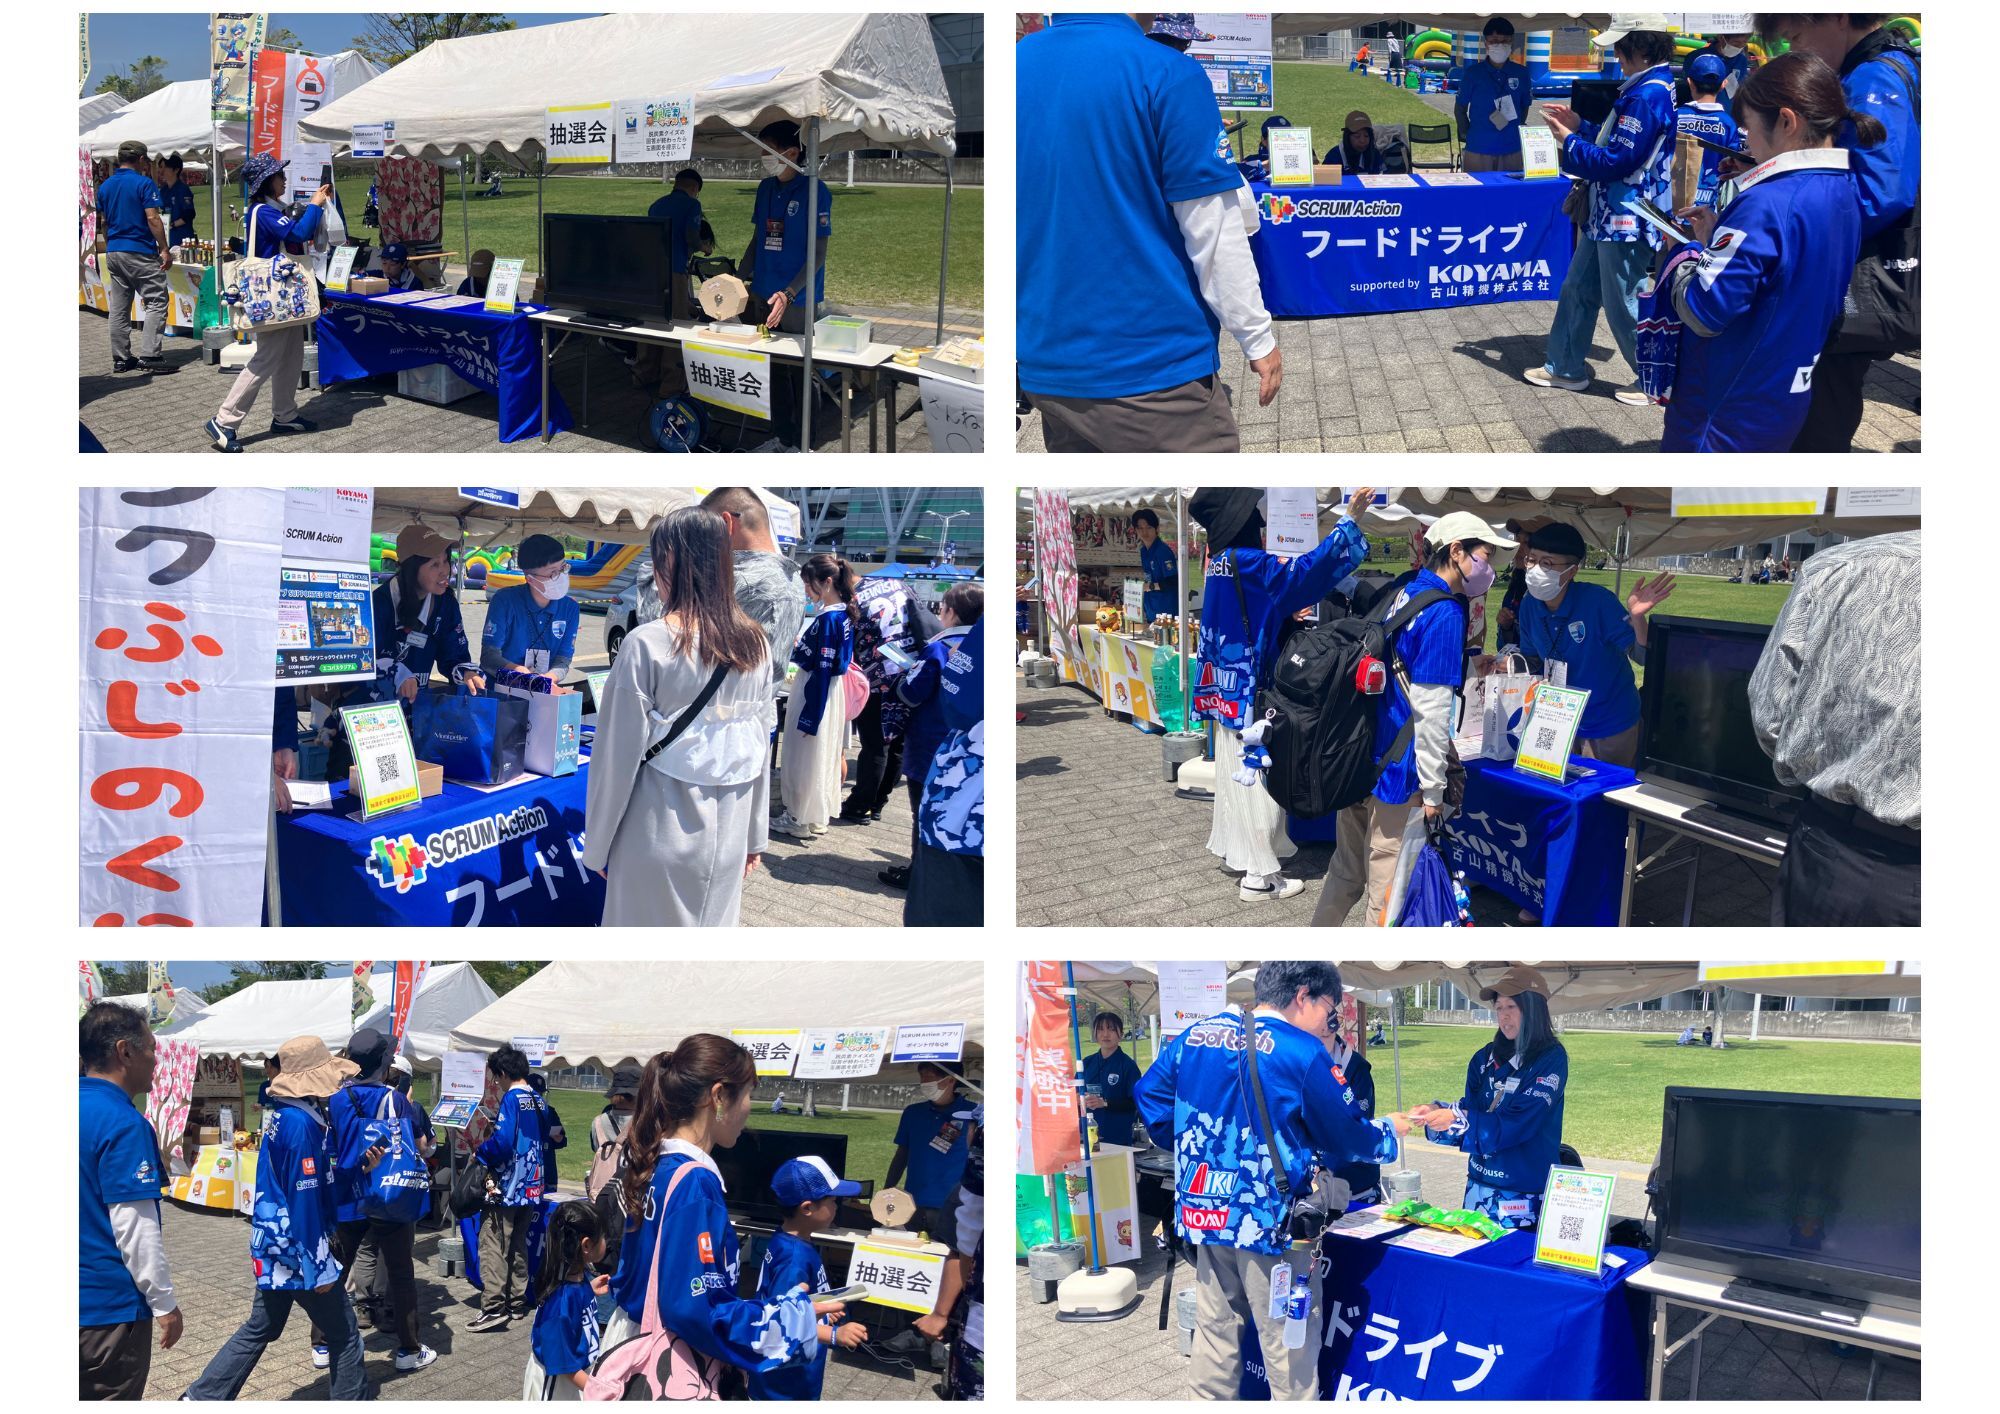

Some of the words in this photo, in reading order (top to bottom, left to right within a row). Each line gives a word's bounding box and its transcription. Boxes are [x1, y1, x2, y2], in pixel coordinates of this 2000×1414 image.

[549, 120, 608, 146] 抽選会
[1298, 200, 1353, 217] SCRUM
[1353, 200, 1401, 217] Action
[1301, 221, 1528, 259] フードドライブ
[1428, 259, 1551, 284] KOYAMA
[1350, 278, 1405, 294] supported
[1407, 277, 1421, 291] by
[1430, 279, 1550, 299] 古山精機株式会社
[689, 360, 763, 398] 抽選会
[336, 488, 368, 500] KOYAMA
[286, 528, 316, 541] SCRUM
[316, 532, 343, 544] Action
[428, 820, 497, 865] SCRUM
[497, 808, 547, 842] Action
[855, 1260, 934, 1295] 抽選会
[1324, 1300, 1505, 1393] ドライブ
